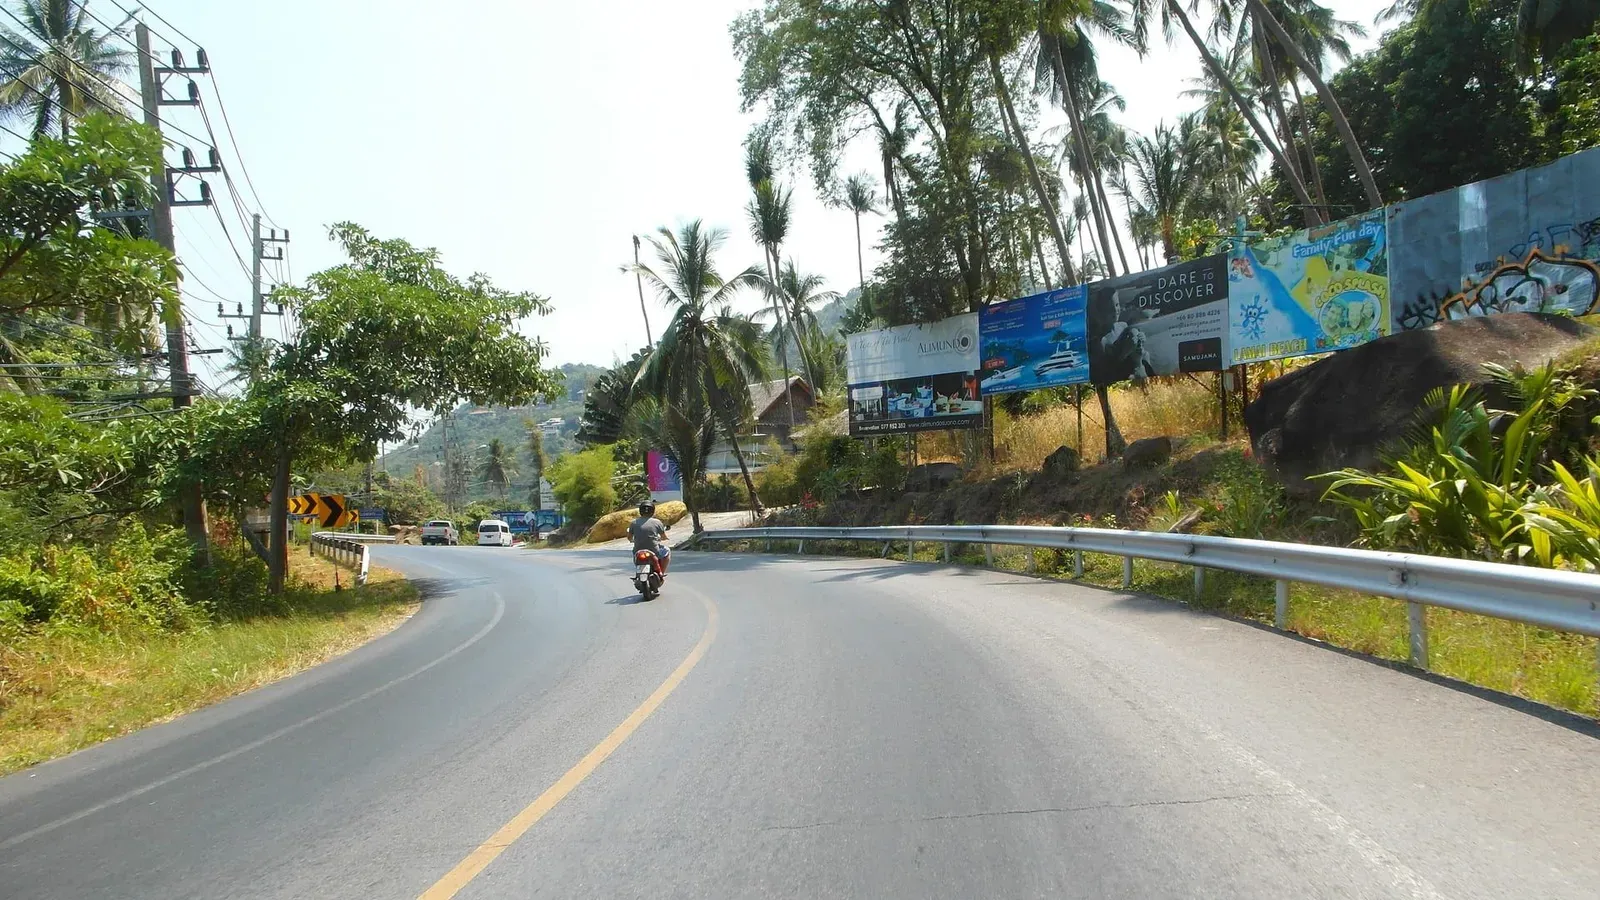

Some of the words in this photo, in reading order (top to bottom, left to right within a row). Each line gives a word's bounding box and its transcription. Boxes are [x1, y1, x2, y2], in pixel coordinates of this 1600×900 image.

[1293, 241, 1332, 258] Family
[1333, 229, 1356, 246] Fun
[1359, 223, 1382, 241] day
[1158, 270, 1196, 291] DARE
[1202, 271, 1214, 281] TO
[1344, 277, 1387, 300] SPLASH
[1139, 283, 1214, 308] DISCOVER
[1182, 352, 1218, 362] SAMUJANA
[1232, 343, 1268, 361] LAMAI
[1269, 338, 1307, 357] BEACH
